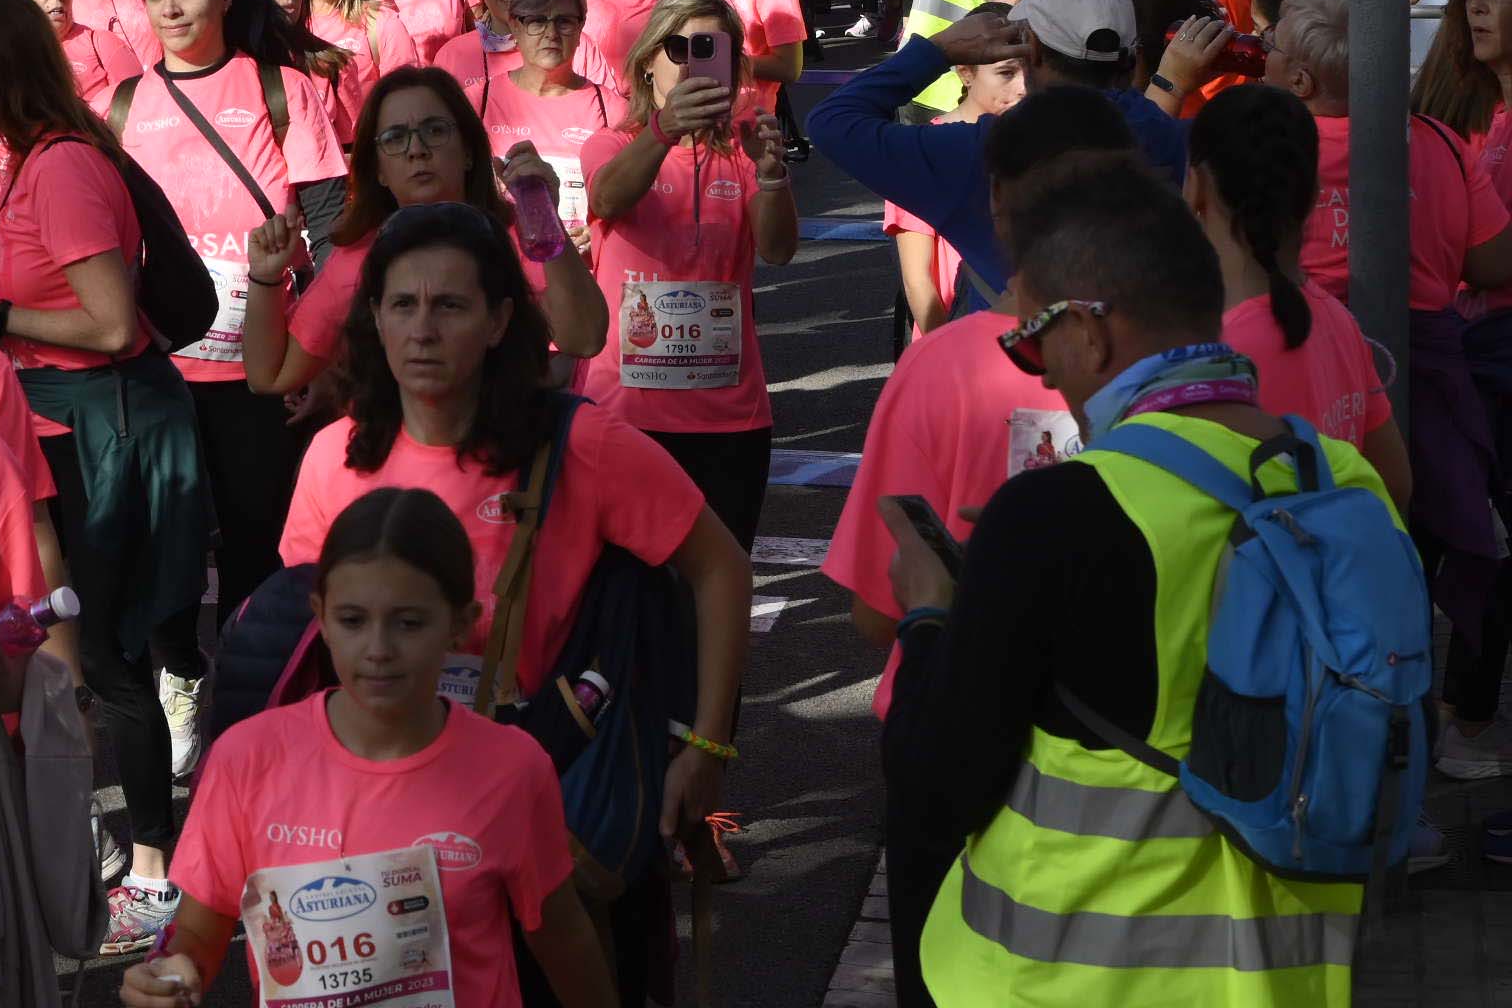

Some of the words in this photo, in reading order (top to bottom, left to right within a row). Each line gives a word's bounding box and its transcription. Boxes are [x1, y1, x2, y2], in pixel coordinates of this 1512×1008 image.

[137, 116, 180, 132] OYSHO
[661, 324, 701, 339] 016
[666, 344, 697, 354] 17910
[631, 372, 667, 382] OYSHO
[266, 823, 343, 850] OYSHO
[383, 872, 422, 888] SUMA
[293, 892, 371, 913] ASTURIANA
[307, 932, 377, 965] 016
[319, 968, 373, 990] 13735
[326, 997, 344, 1008] DE
[346, 991, 361, 1005] LA
[364, 983, 403, 1002] MUJER
